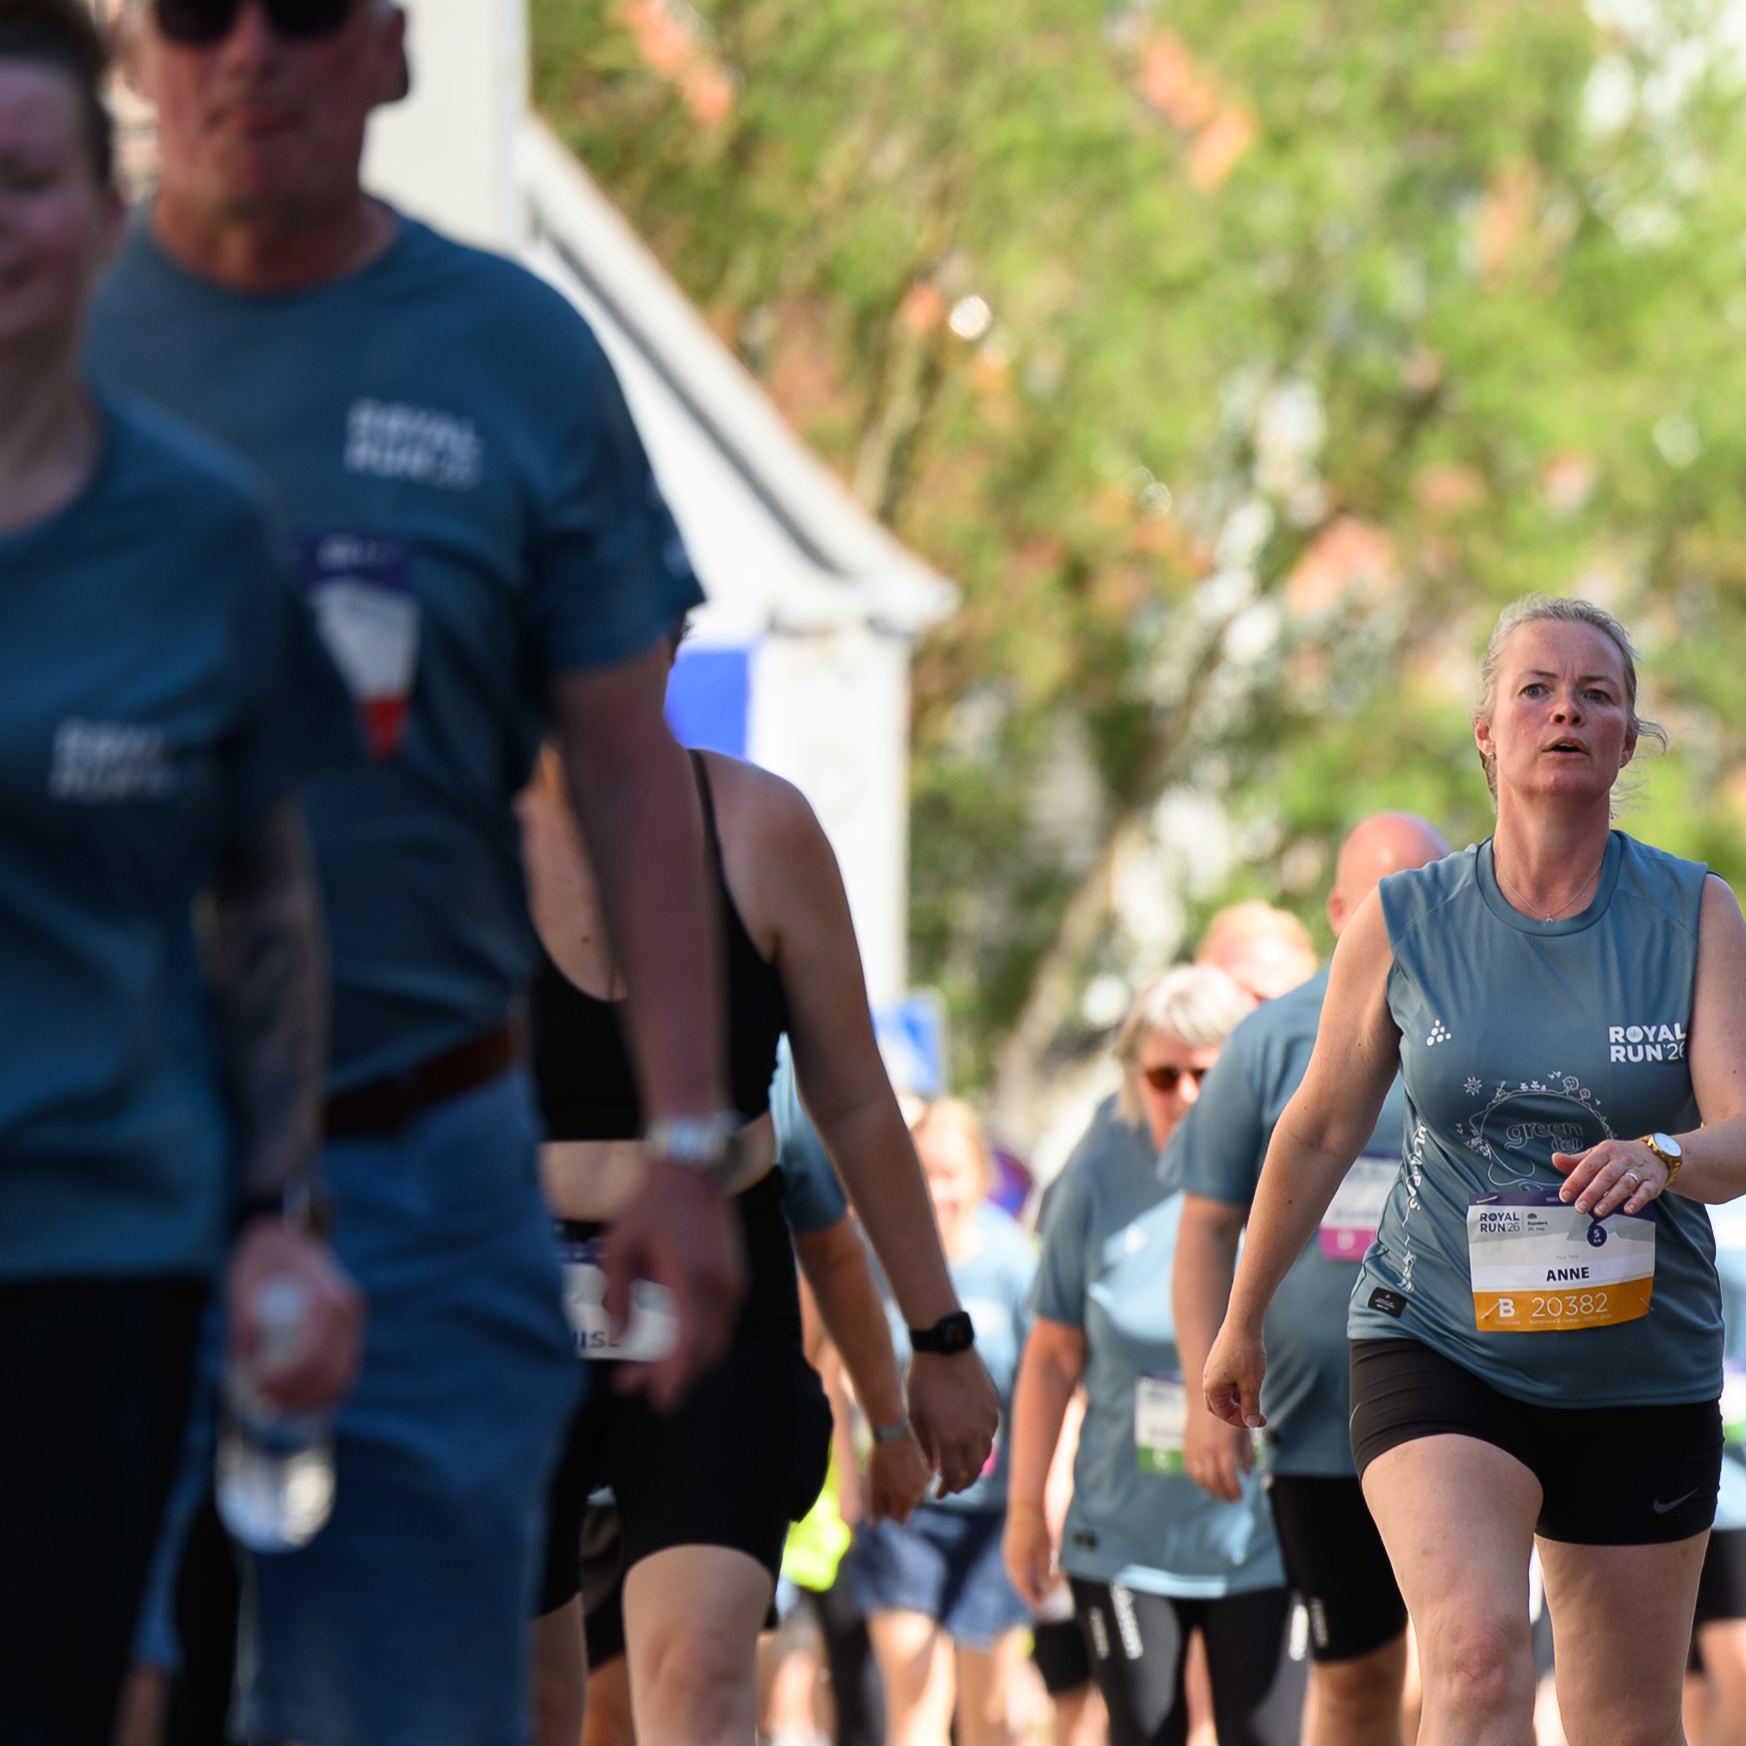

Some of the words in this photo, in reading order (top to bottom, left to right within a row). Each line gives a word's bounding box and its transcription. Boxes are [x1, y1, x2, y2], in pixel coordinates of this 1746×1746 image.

[1609, 1022, 1686, 1043] ROYAL
[1504, 1122, 1583, 1150] green
[1480, 1212, 1519, 1221] ROYAL
[1594, 1229, 1600, 1238] 5
[1546, 1266, 1590, 1282] ANNE
[1498, 1298, 1515, 1317] B
[1531, 1292, 1608, 1317] 20382
